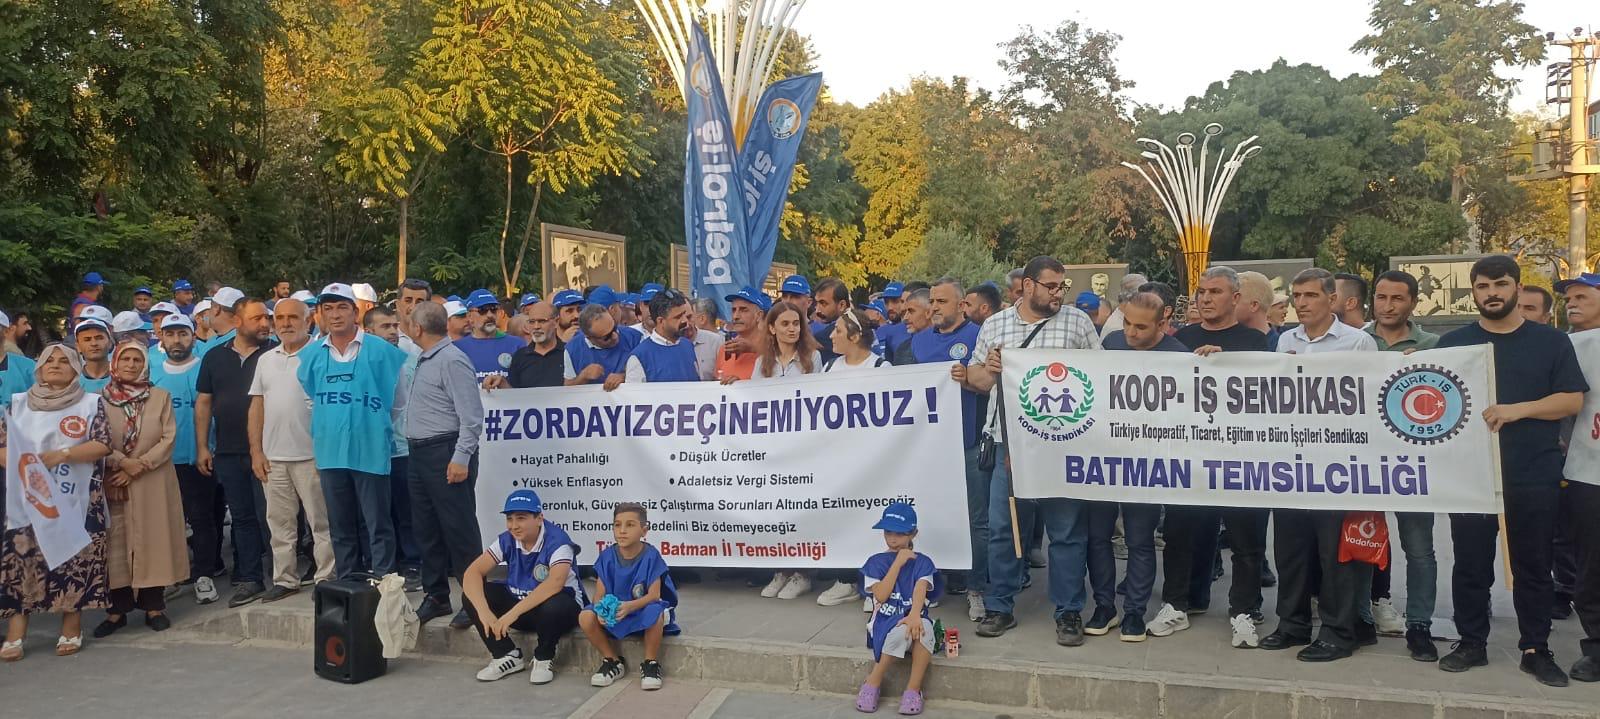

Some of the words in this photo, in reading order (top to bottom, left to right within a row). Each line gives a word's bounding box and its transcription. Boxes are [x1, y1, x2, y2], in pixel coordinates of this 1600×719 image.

[1109, 374, 1184, 411] KOOP-
[1194, 366, 1218, 424] İŞ
[1226, 365, 1366, 415] SENDİKASI
[485, 389, 914, 444] #ZORDAYIZGEÇİNEMİYORUZ
[925, 387, 939, 424] !
[1109, 422, 1140, 441] Türkiye
[1142, 423, 1188, 442] Kooperatif,
[1191, 425, 1224, 443] Ticaret,
[1226, 426, 1254, 444] Eğitim
[1256, 430, 1267, 443] ve
[1268, 426, 1289, 443] Büro
[1290, 424, 1322, 447] İşçileri
[1324, 428, 1369, 444] Sendikası
[1409, 423, 1444, 435] 1952
[520, 454, 554, 467] Hayat
[556, 452, 609, 466] Pahalılığı
[679, 451, 717, 464] Düşük
[721, 448, 767, 462] Ücretler
[521, 476, 563, 489] Yüksek
[566, 476, 624, 490] Enflasyon
[678, 475, 733, 487] Adaletsiz
[736, 474, 767, 489] Vergi
[769, 472, 814, 486] Sistemi
[1065, 455, 1191, 489] BATMAN
[1203, 454, 1429, 496] TEMSİLCİLİĞİ
[542, 499, 588, 512] eronluk,
[660, 498, 715, 513] Çalıştırma
[718, 499, 773, 511] Sorunları
[775, 498, 818, 511] Altında
[691, 520, 710, 532] Biz
[711, 520, 797, 535] ödemeyeceğiz
[661, 541, 718, 557] Batman
[721, 538, 732, 557] İl
[735, 541, 827, 561] Temsilciliği
